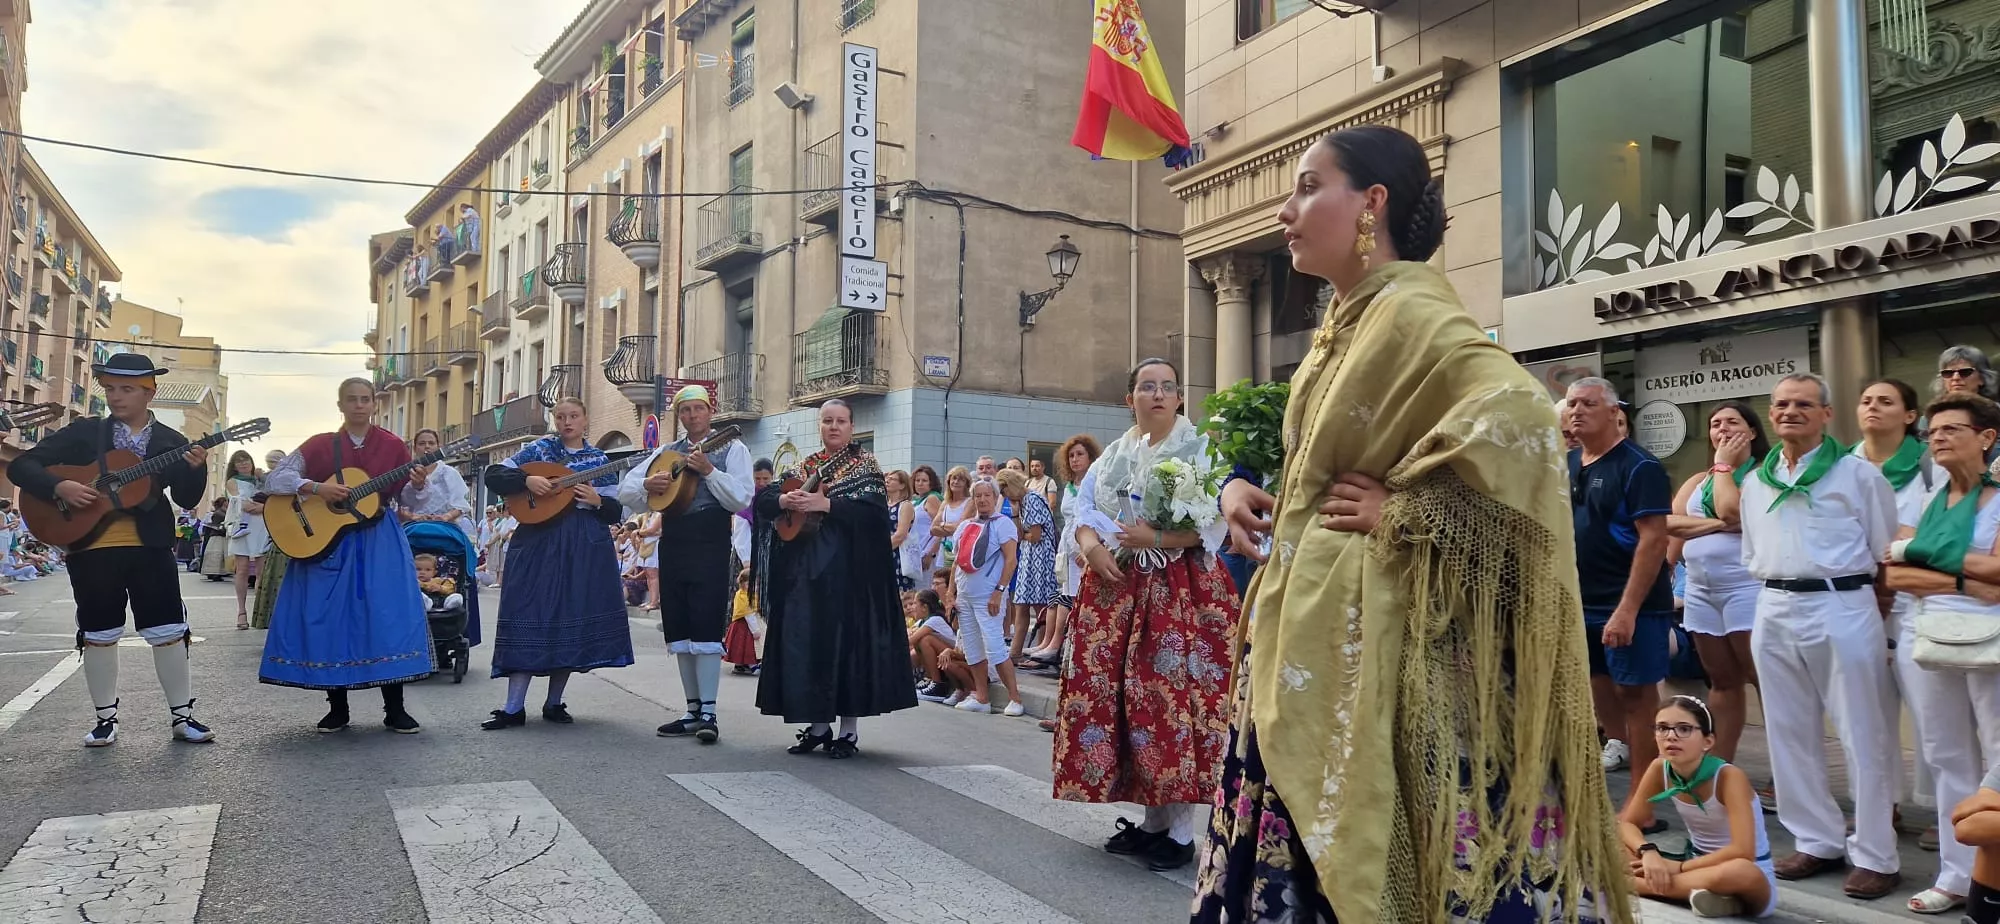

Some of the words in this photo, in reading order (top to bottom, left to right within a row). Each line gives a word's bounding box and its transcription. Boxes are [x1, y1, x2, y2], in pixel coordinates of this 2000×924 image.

[850, 52, 871, 137] Gastro
[850, 264, 879, 277] Comida
[845, 275, 885, 289] Tradicional
[1645, 370, 1705, 391] CASERÍO
[1710, 358, 1796, 383] ARAGONÉS
[1643, 411, 1674, 420] RESERVAS
